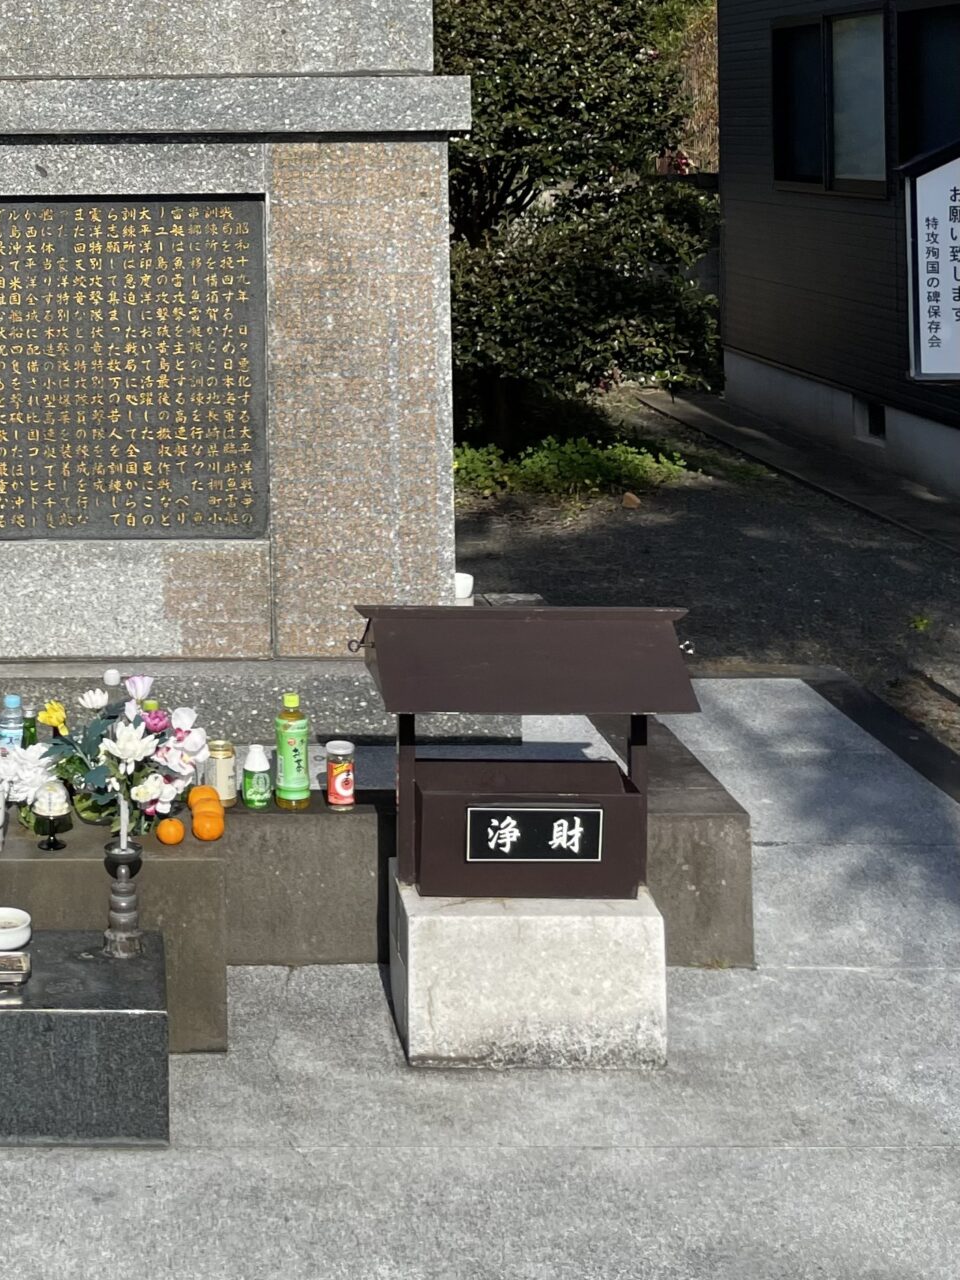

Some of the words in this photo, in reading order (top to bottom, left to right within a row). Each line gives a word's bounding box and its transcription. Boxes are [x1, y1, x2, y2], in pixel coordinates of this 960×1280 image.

[235, 223, 250, 302] 昭和十九年
[925, 216, 941, 348] 特攻殉国の碑保存会
[487, 815, 584, 854] 浄財
